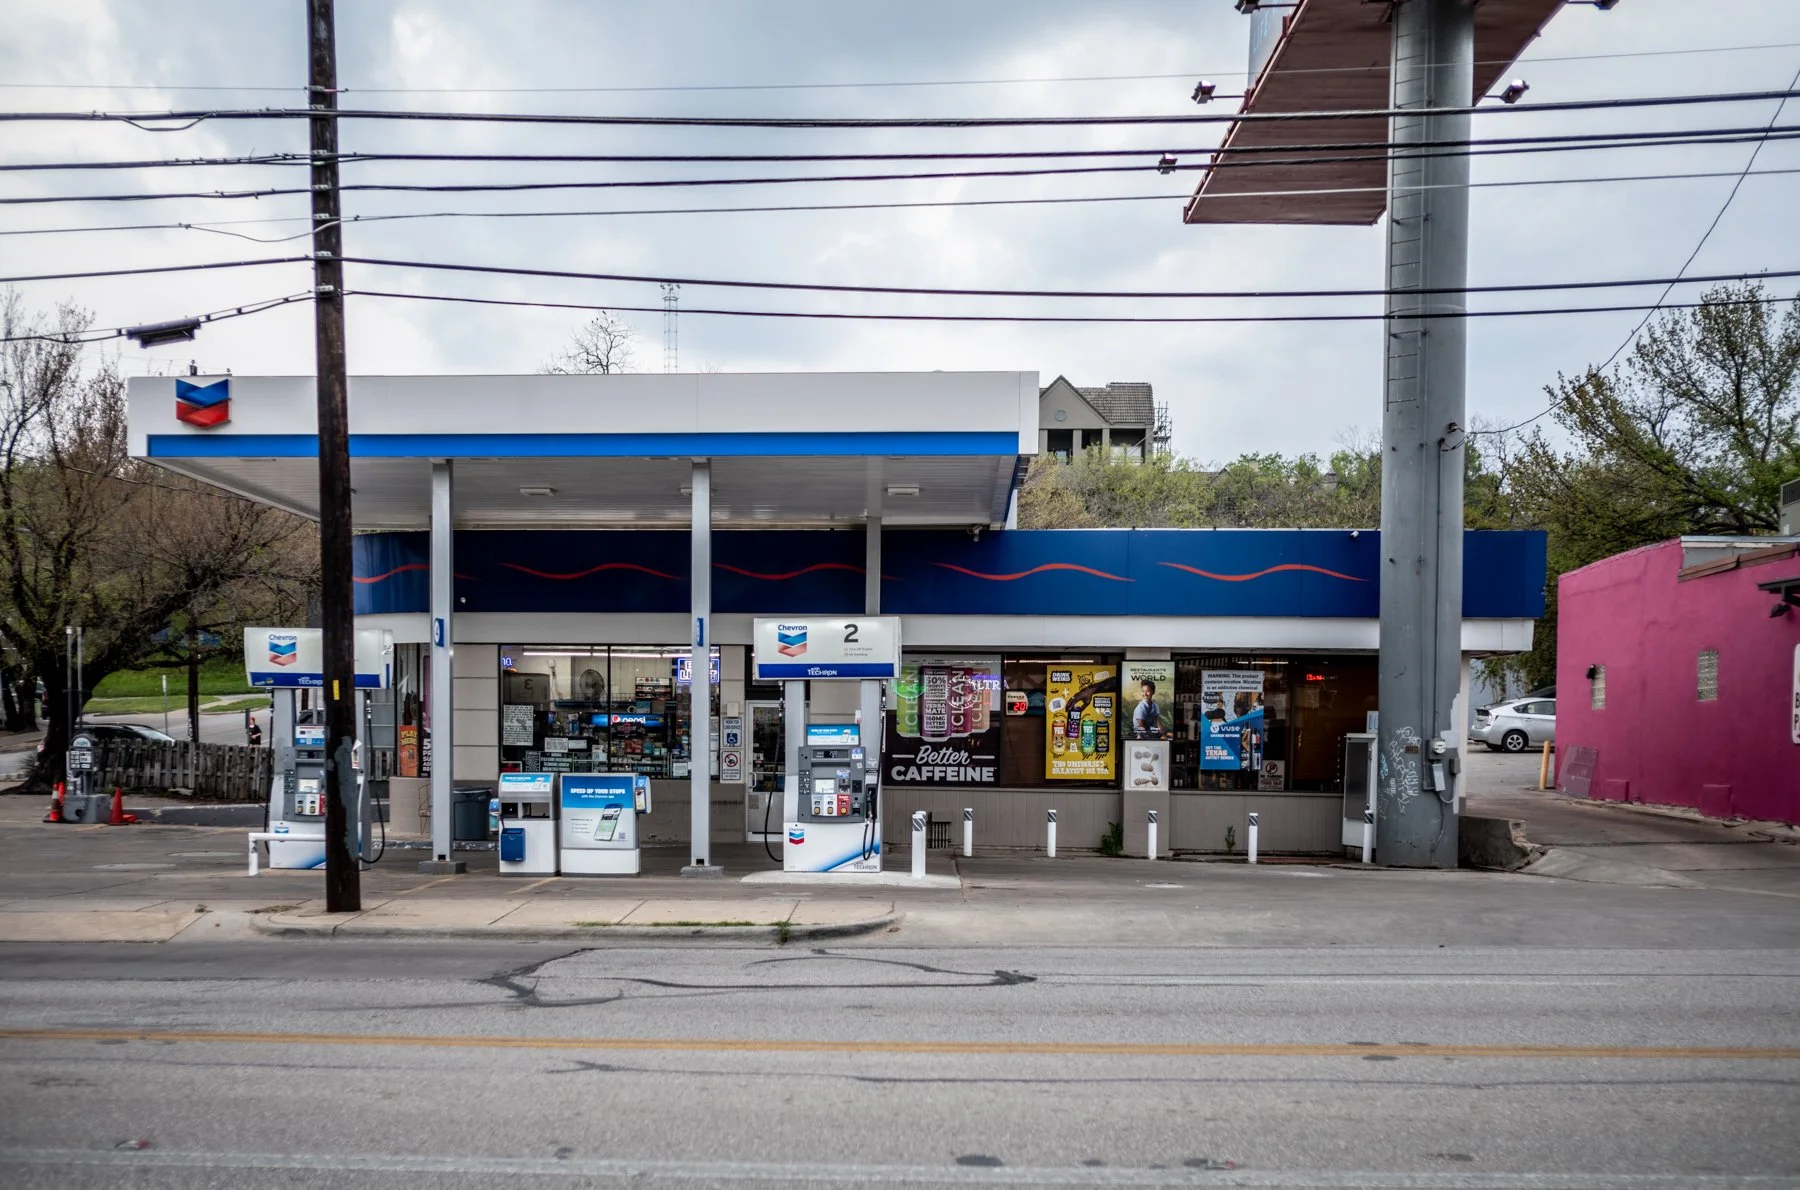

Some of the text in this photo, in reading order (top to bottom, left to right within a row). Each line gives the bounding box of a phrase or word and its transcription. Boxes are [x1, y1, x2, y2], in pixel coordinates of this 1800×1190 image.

[778, 624, 808, 632] Chevron
[844, 624, 859, 643] 2
[807, 669, 838, 677] TECHRON
[1131, 674, 1167, 682] WORLD
[951, 670, 964, 726] CLEAN
[1013, 702, 1026, 711] 20
[401, 730, 417, 738] PLAY
[916, 745, 970, 765] Better
[891, 766, 995, 782] CAFFEINE
